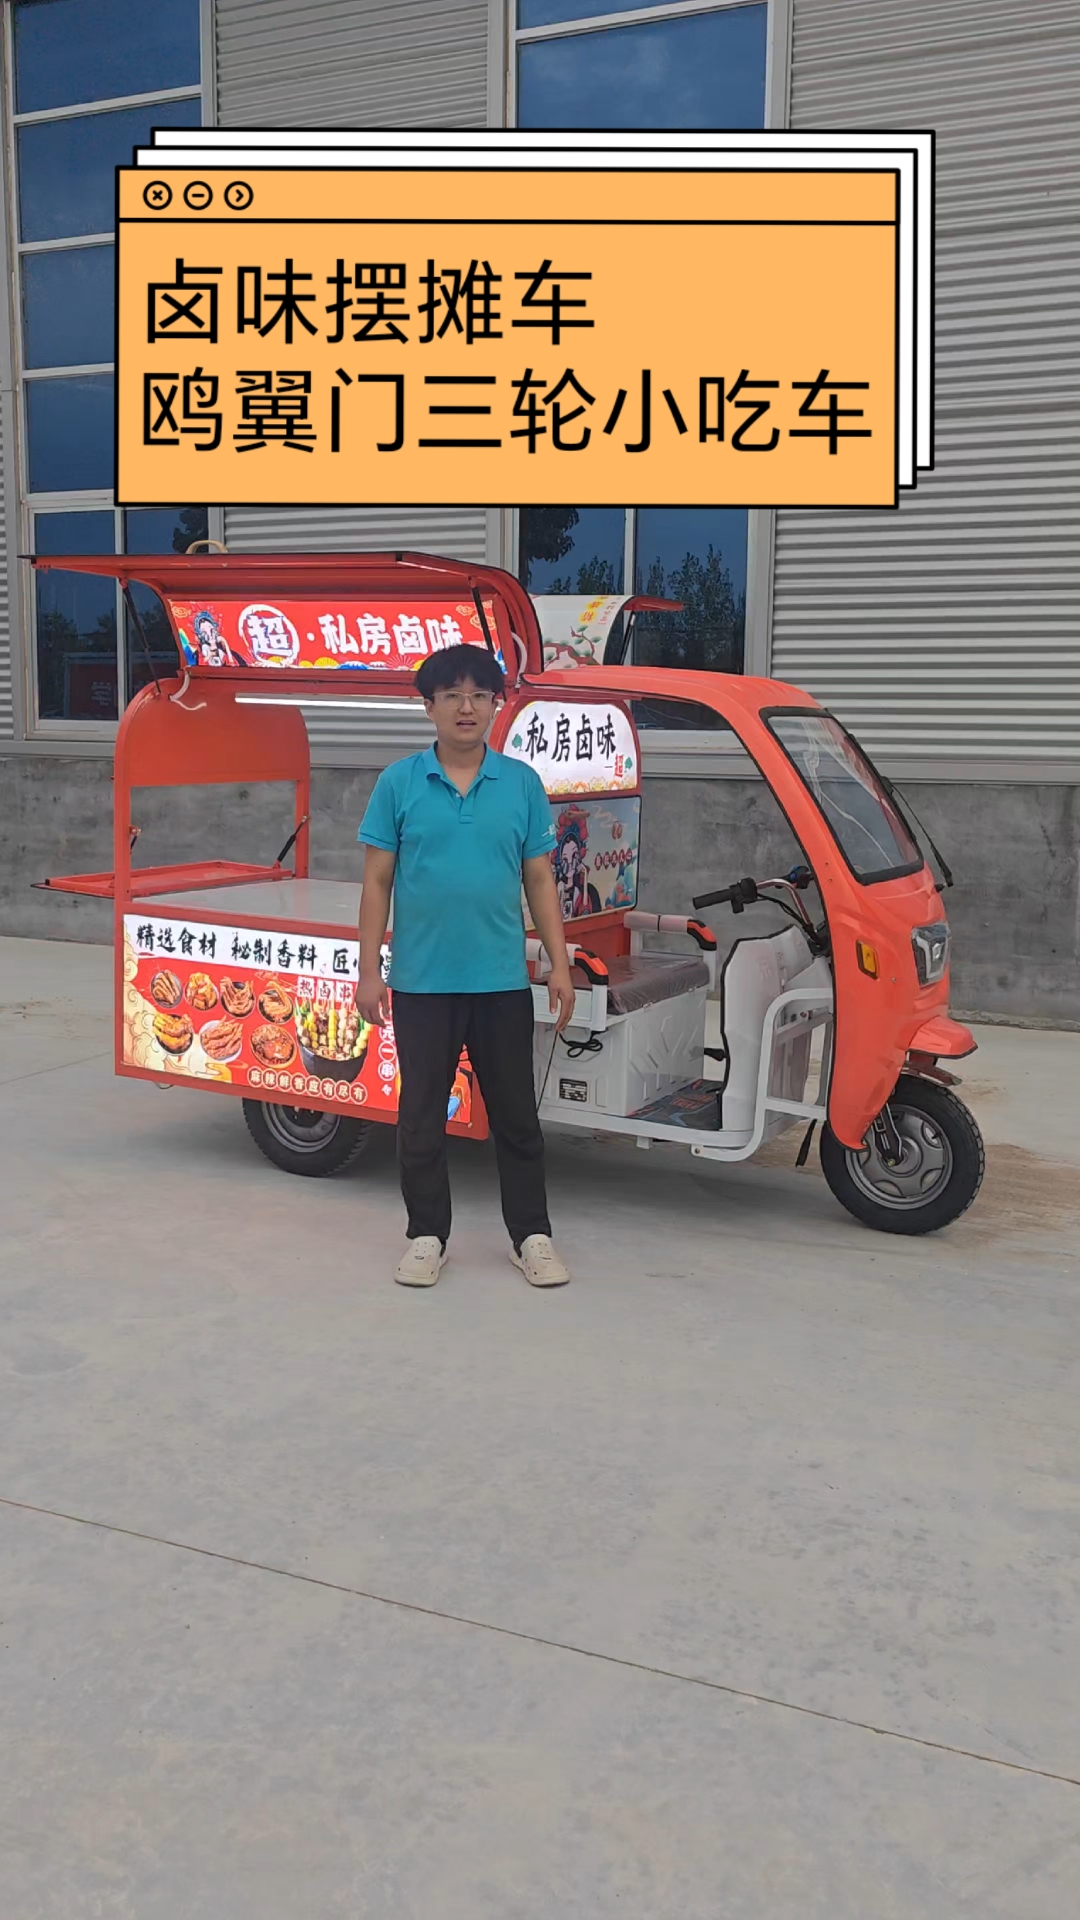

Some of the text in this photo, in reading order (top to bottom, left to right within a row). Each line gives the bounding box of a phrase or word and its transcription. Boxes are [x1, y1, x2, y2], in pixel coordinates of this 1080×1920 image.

[525, 711, 616, 762] 私房卤味
[136, 923, 218, 959] 精选食材
[231, 933, 319, 971] 秘制香料
[249, 1067, 365, 1101] 麻辣鲜香应有尽有
